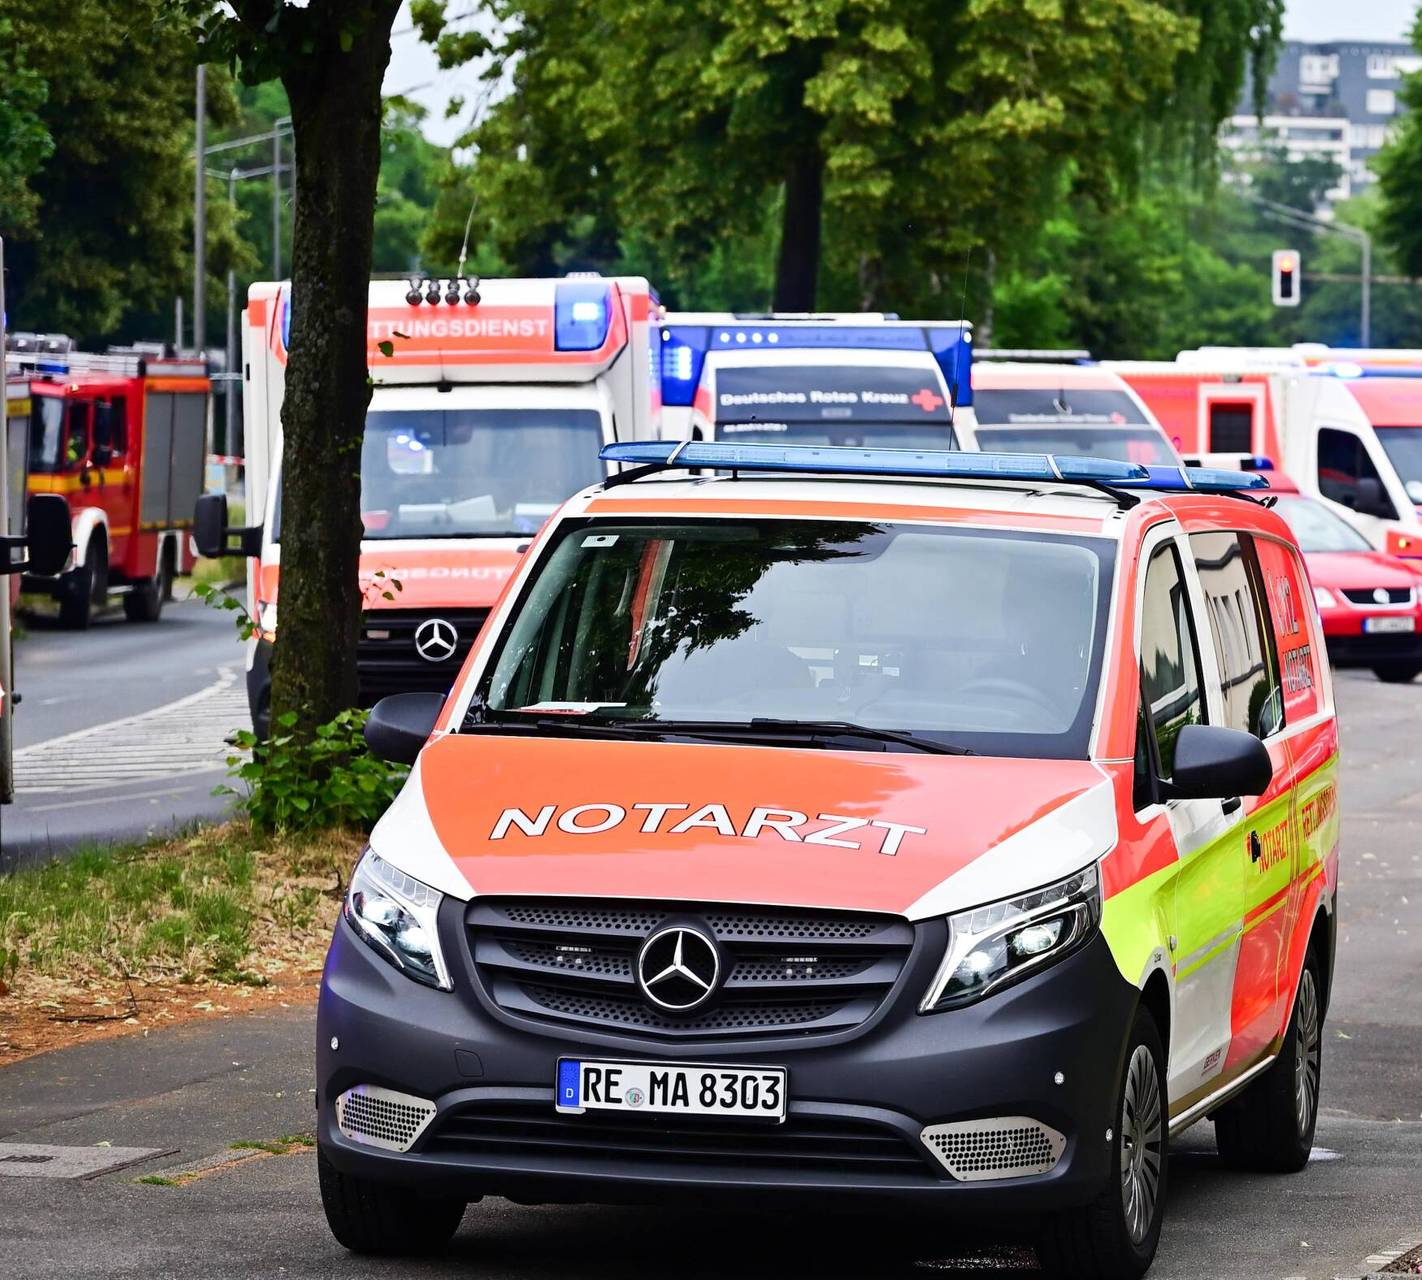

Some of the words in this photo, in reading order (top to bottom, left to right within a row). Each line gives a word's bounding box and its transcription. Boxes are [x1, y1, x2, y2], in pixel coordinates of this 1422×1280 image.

[370, 319, 549, 338] TTUNGSDIENST
[489, 802, 928, 857] NOTARZT
[1258, 819, 1290, 875] NOTARZT
[565, 1088, 574, 1099] D
[583, 1067, 623, 1104] RE
[649, 1070, 690, 1107] MA
[699, 1073, 781, 1110] 8303
